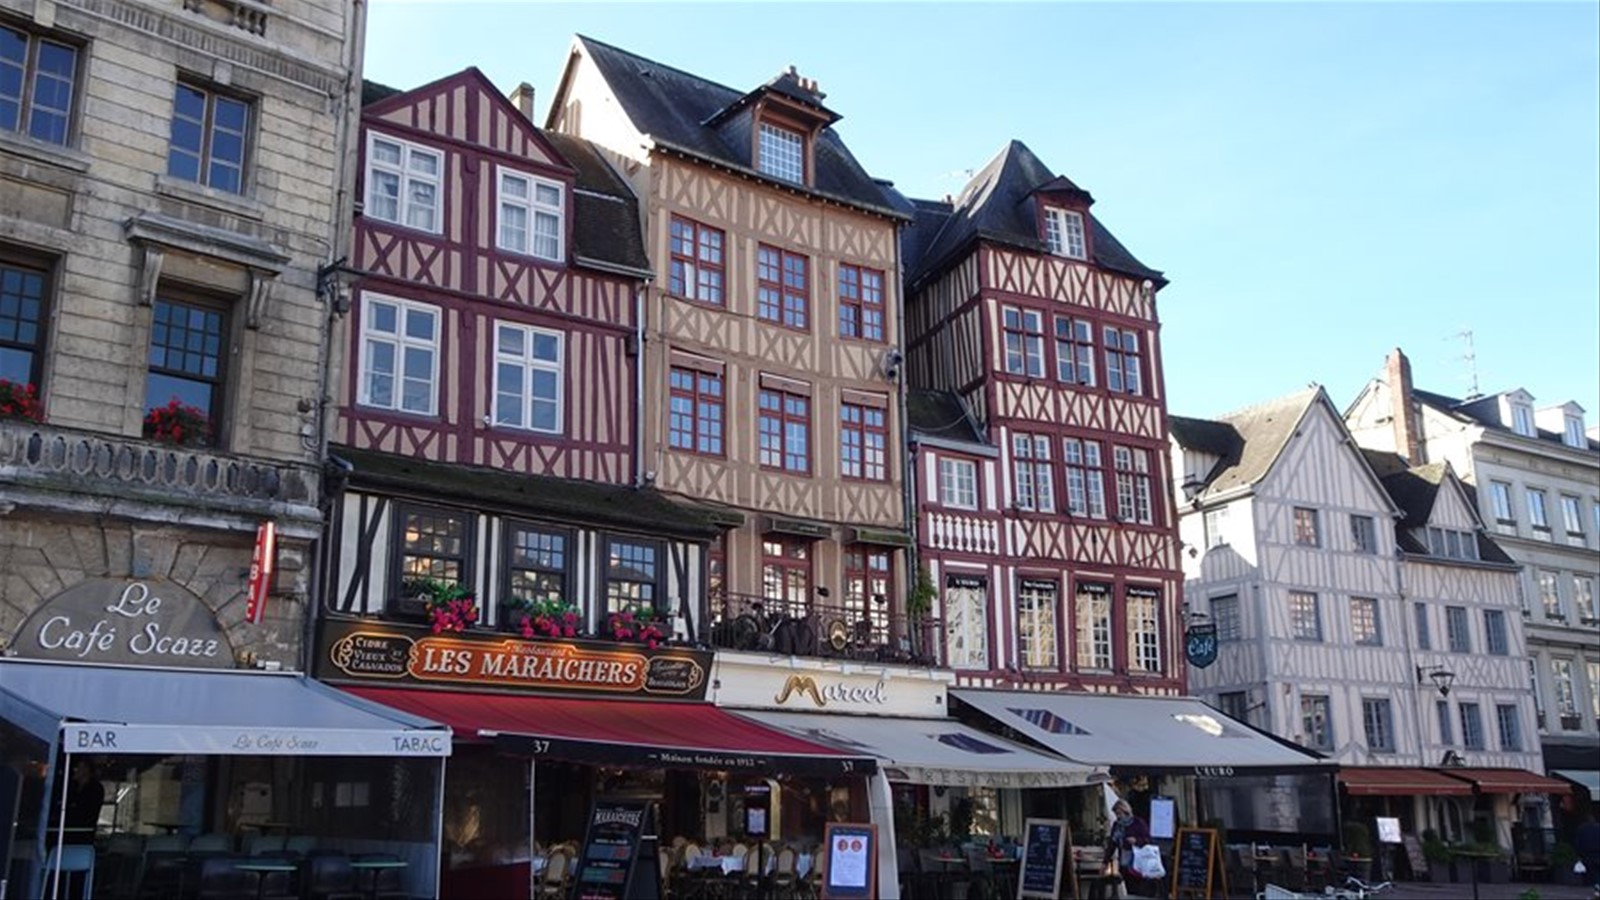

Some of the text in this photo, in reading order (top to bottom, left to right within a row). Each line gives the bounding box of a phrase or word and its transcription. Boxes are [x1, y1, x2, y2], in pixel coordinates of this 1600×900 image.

[107, 582, 161, 617] Le
[39, 616, 218, 657] Café Scazz
[1188, 636, 1214, 656] Café
[423, 648, 638, 684] LES MARAICHERS
[775, 674, 887, 707] Marcel
[77, 731, 117, 748] BAR
[392, 737, 442, 752] TABAC
[533, 740, 550, 753] 37
